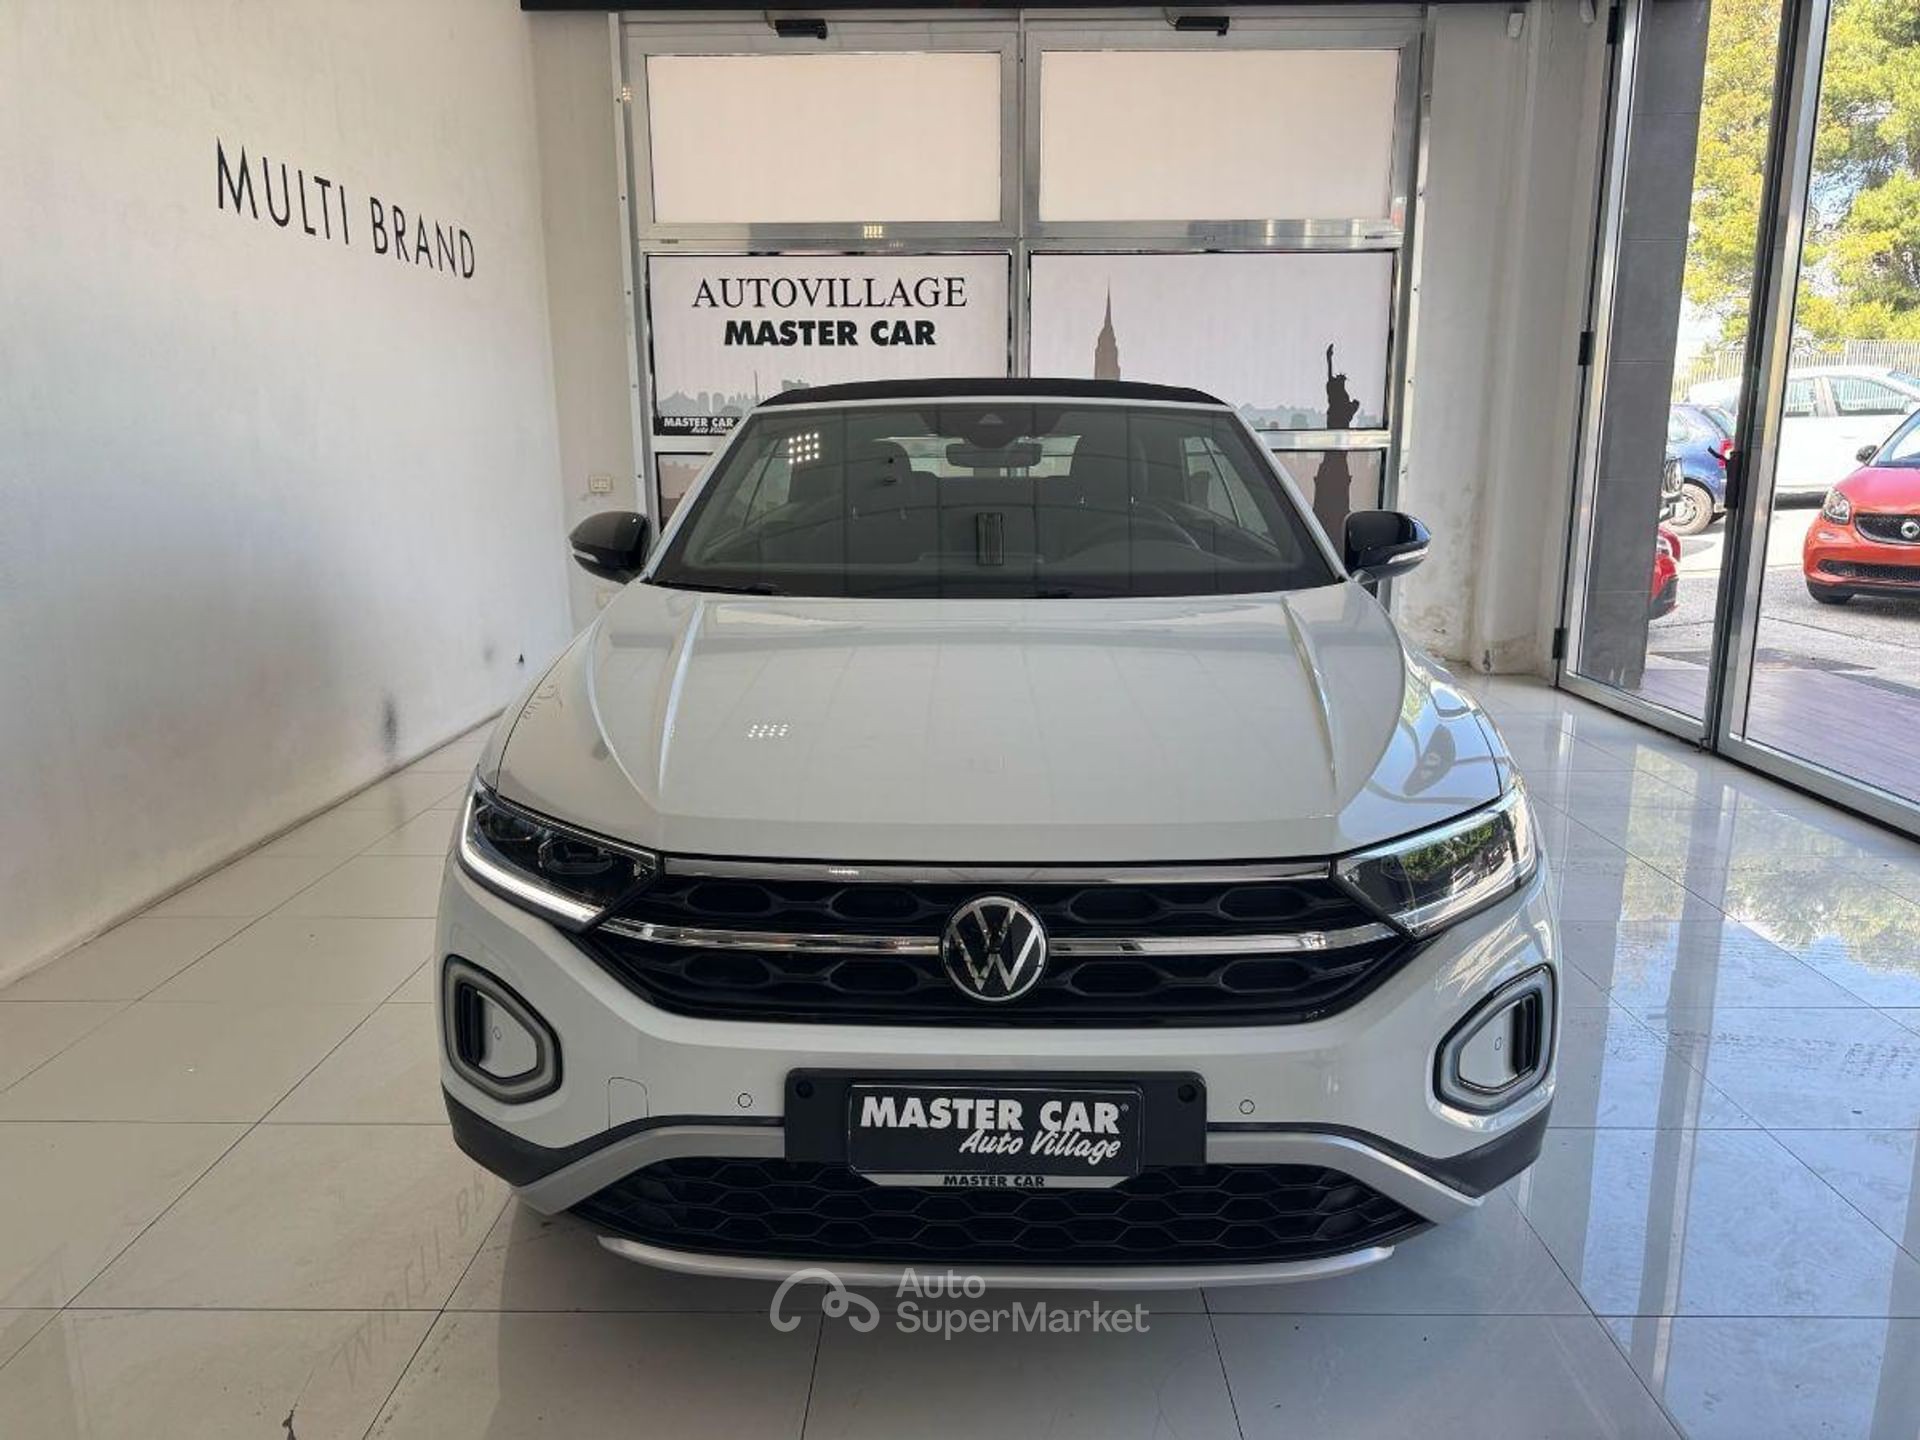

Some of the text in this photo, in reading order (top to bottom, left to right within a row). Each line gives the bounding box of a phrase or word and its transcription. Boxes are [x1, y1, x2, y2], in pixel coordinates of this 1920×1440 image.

[215, 135, 475, 278] MULTI BRAND
[692, 277, 968, 308] AUTOVILLAGE
[724, 320, 936, 346] MASTER CAR
[663, 417, 734, 428] MASTER CAR
[861, 1096, 1024, 1130] MASTER
[959, 1129, 1121, 1166] Auto Village
[943, 1174, 1045, 1188] MASTER CAR
